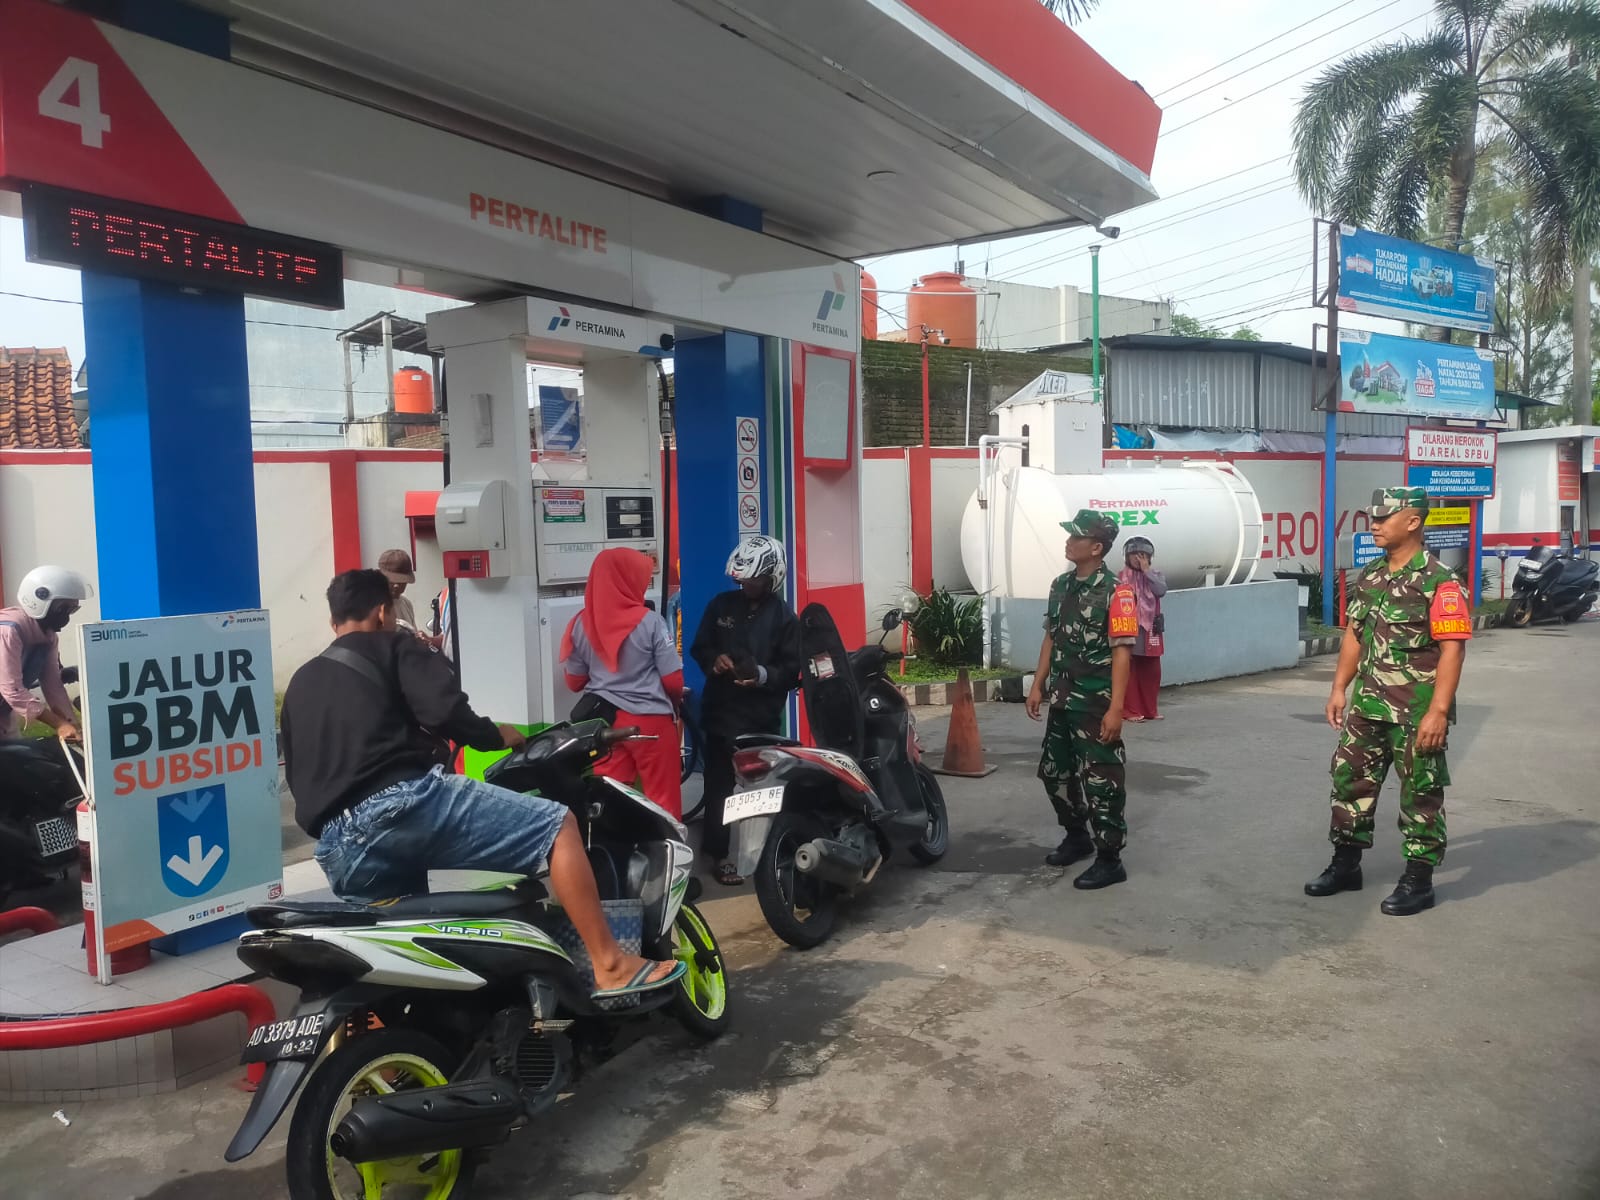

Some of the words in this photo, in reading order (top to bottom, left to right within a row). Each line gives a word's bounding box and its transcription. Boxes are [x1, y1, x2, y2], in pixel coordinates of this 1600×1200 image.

[38, 55, 111, 149] 4
[469, 192, 608, 254] PERTALITE
[1375, 248, 1394, 261] TUKAR
[1393, 252, 1408, 264] POIN
[1375, 266, 1408, 286] HADIAH
[575, 320, 626, 339] PERTAMINA
[812, 321, 849, 339] PERTAMINA
[1438, 367, 1456, 378] NATAL
[1422, 433, 1454, 447] DILARANG
[1454, 436, 1485, 448] MEROKOK
[1417, 446, 1428, 457] DI
[1429, 447, 1461, 458] AREAL
[1464, 448, 1489, 460] SPBU
[1089, 499, 1168, 508] PERTAMINA
[108, 648, 256, 700] JALUR
[107, 685, 261, 761] BBM
[113, 738, 262, 796] SUBSIDI
[425, 923, 503, 938] VARIO
[246, 1025, 266, 1048] AD
[263, 1019, 298, 1044] 3379
[295, 1014, 325, 1037] ADE
